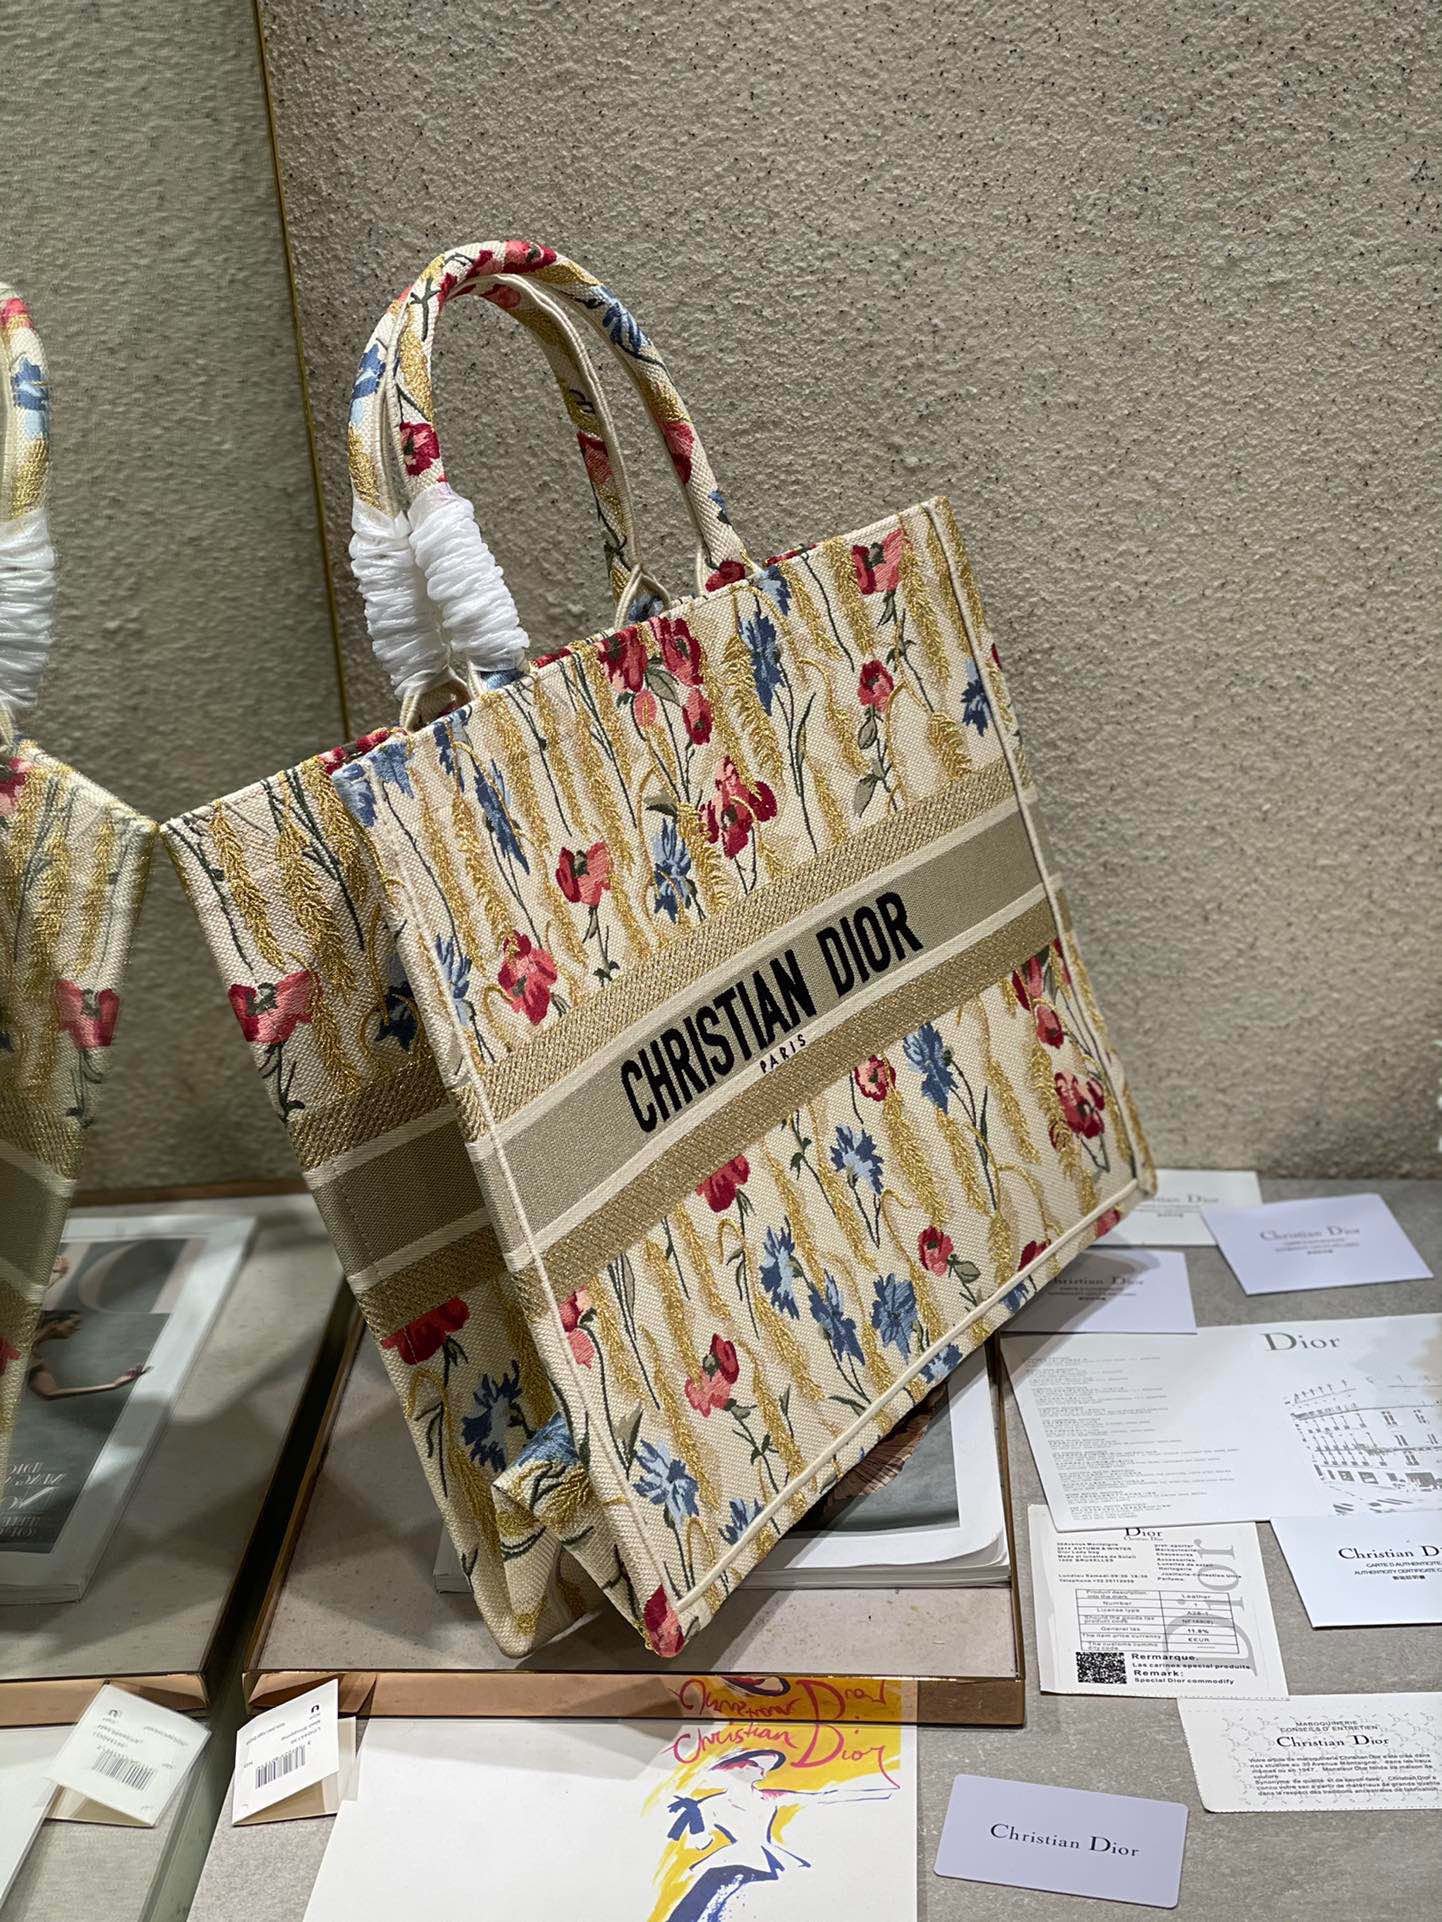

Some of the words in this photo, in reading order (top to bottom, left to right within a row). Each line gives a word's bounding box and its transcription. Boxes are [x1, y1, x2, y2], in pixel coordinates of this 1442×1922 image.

[620, 949, 817, 1133] CHRISTIAN
[815, 892, 924, 998] DIOR
[759, 1033, 807, 1074] PARIS
[1260, 1230, 1322, 1240] Christian
[1326, 1225, 1360, 1236] Dior
[1261, 1332, 1340, 1351] Dior
[1123, 1528, 1162, 1537] Dior
[1338, 1547, 1414, 1559] Christian
[1421, 1545, 1442, 1557] D
[1164, 1538, 1258, 1677] Dior
[1276, 1736, 1345, 1747] Christian
[1351, 1734, 1389, 1745] Dior
[658, 1722, 798, 1764] Christian
[791, 1724, 900, 1789] Dior
[990, 1823, 1081, 1849] Christian
[1088, 1836, 1140, 1857] Dior
